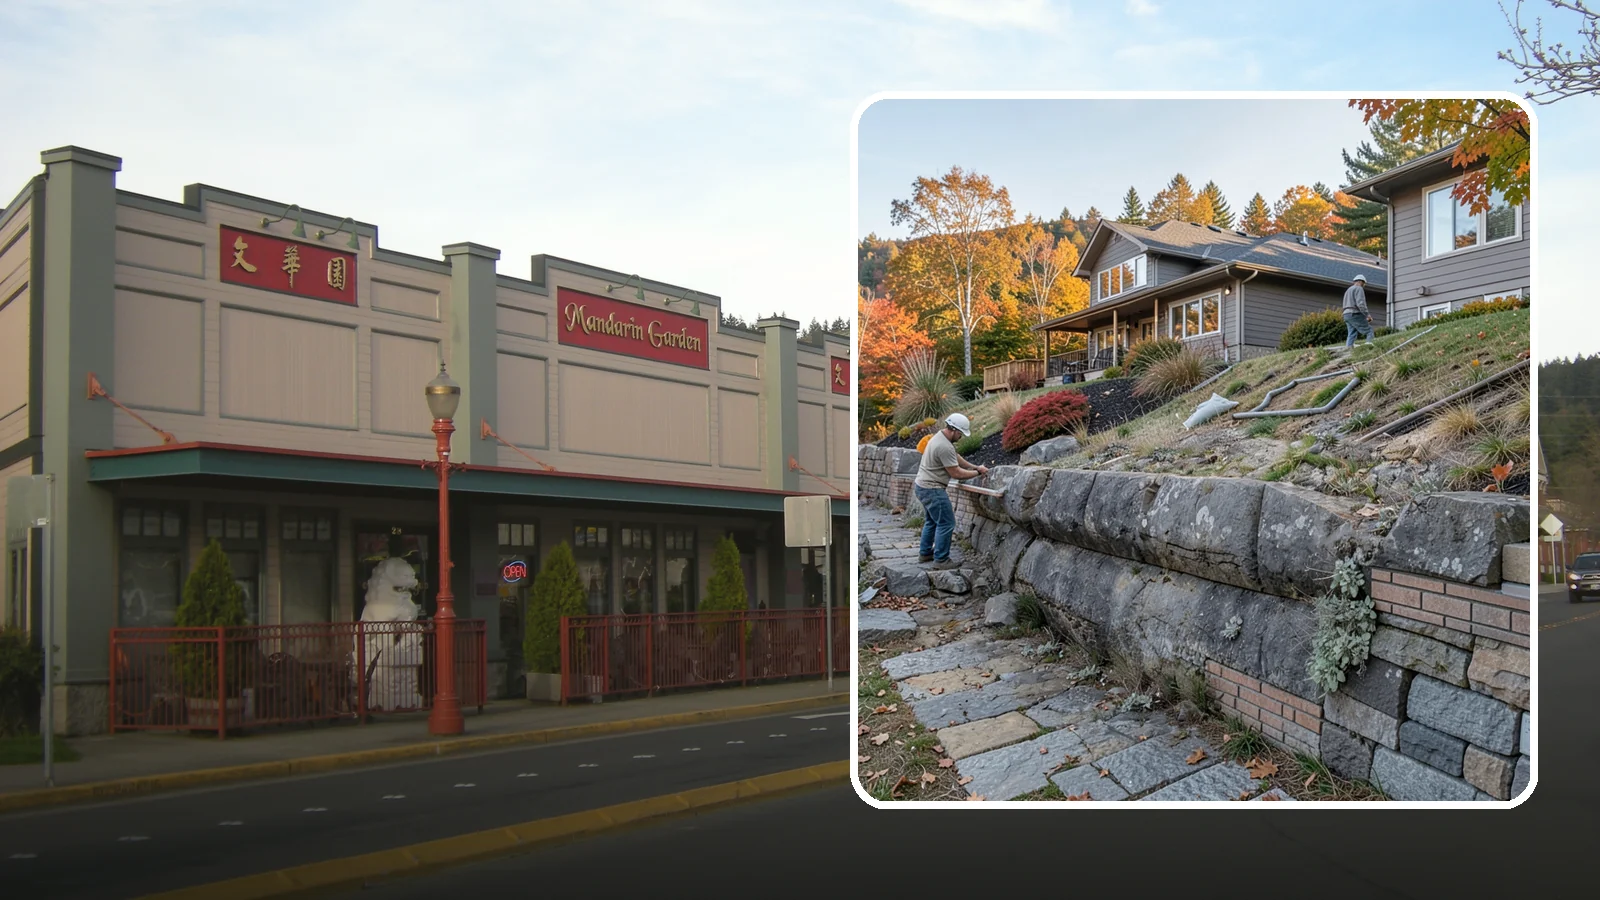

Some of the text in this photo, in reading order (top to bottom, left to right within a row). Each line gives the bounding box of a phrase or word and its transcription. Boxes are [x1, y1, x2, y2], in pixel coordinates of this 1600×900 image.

[564, 302, 701, 352] Mandarin Garden
[503, 565, 527, 578] OPEN
